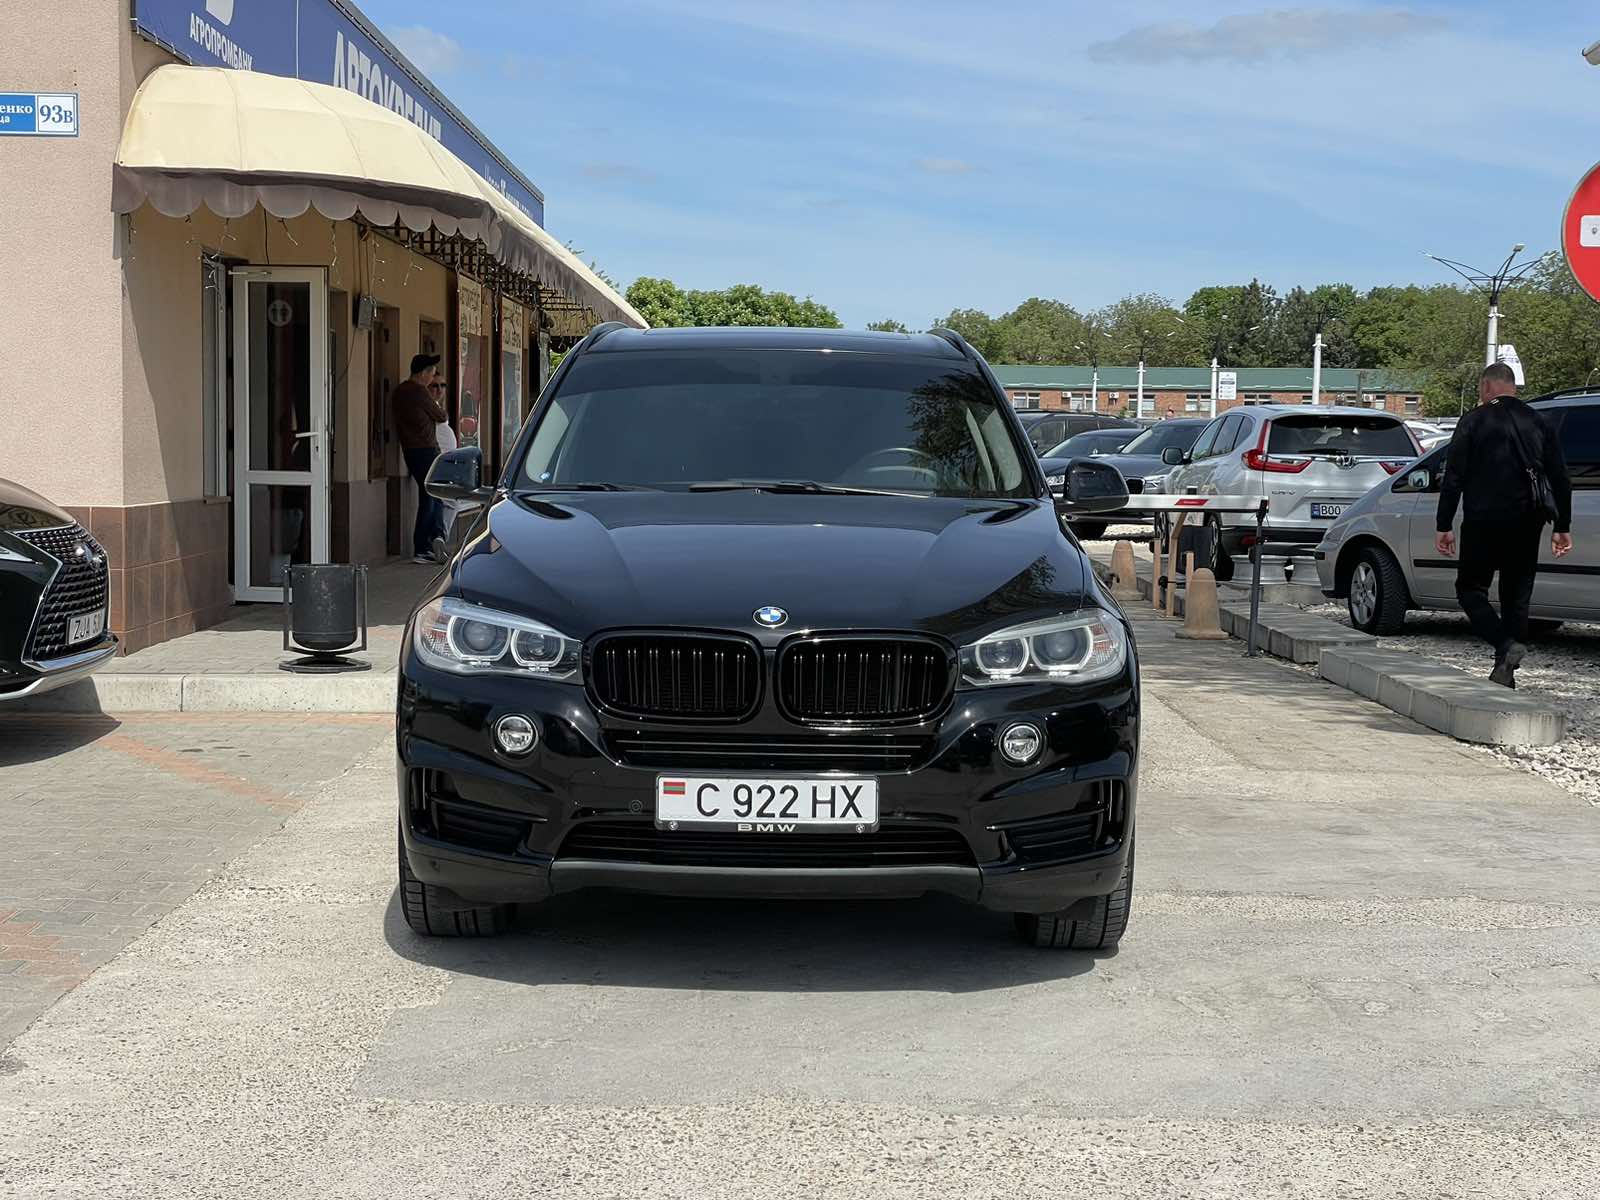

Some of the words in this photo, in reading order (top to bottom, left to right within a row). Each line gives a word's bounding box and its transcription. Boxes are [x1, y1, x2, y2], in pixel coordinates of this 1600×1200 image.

[190, 12, 253, 71] АГРОПРОМБАНК
[696, 782, 720, 817] C
[733, 783, 799, 818] 922
[811, 785, 863, 818] HX
[737, 823, 796, 832] BMW
